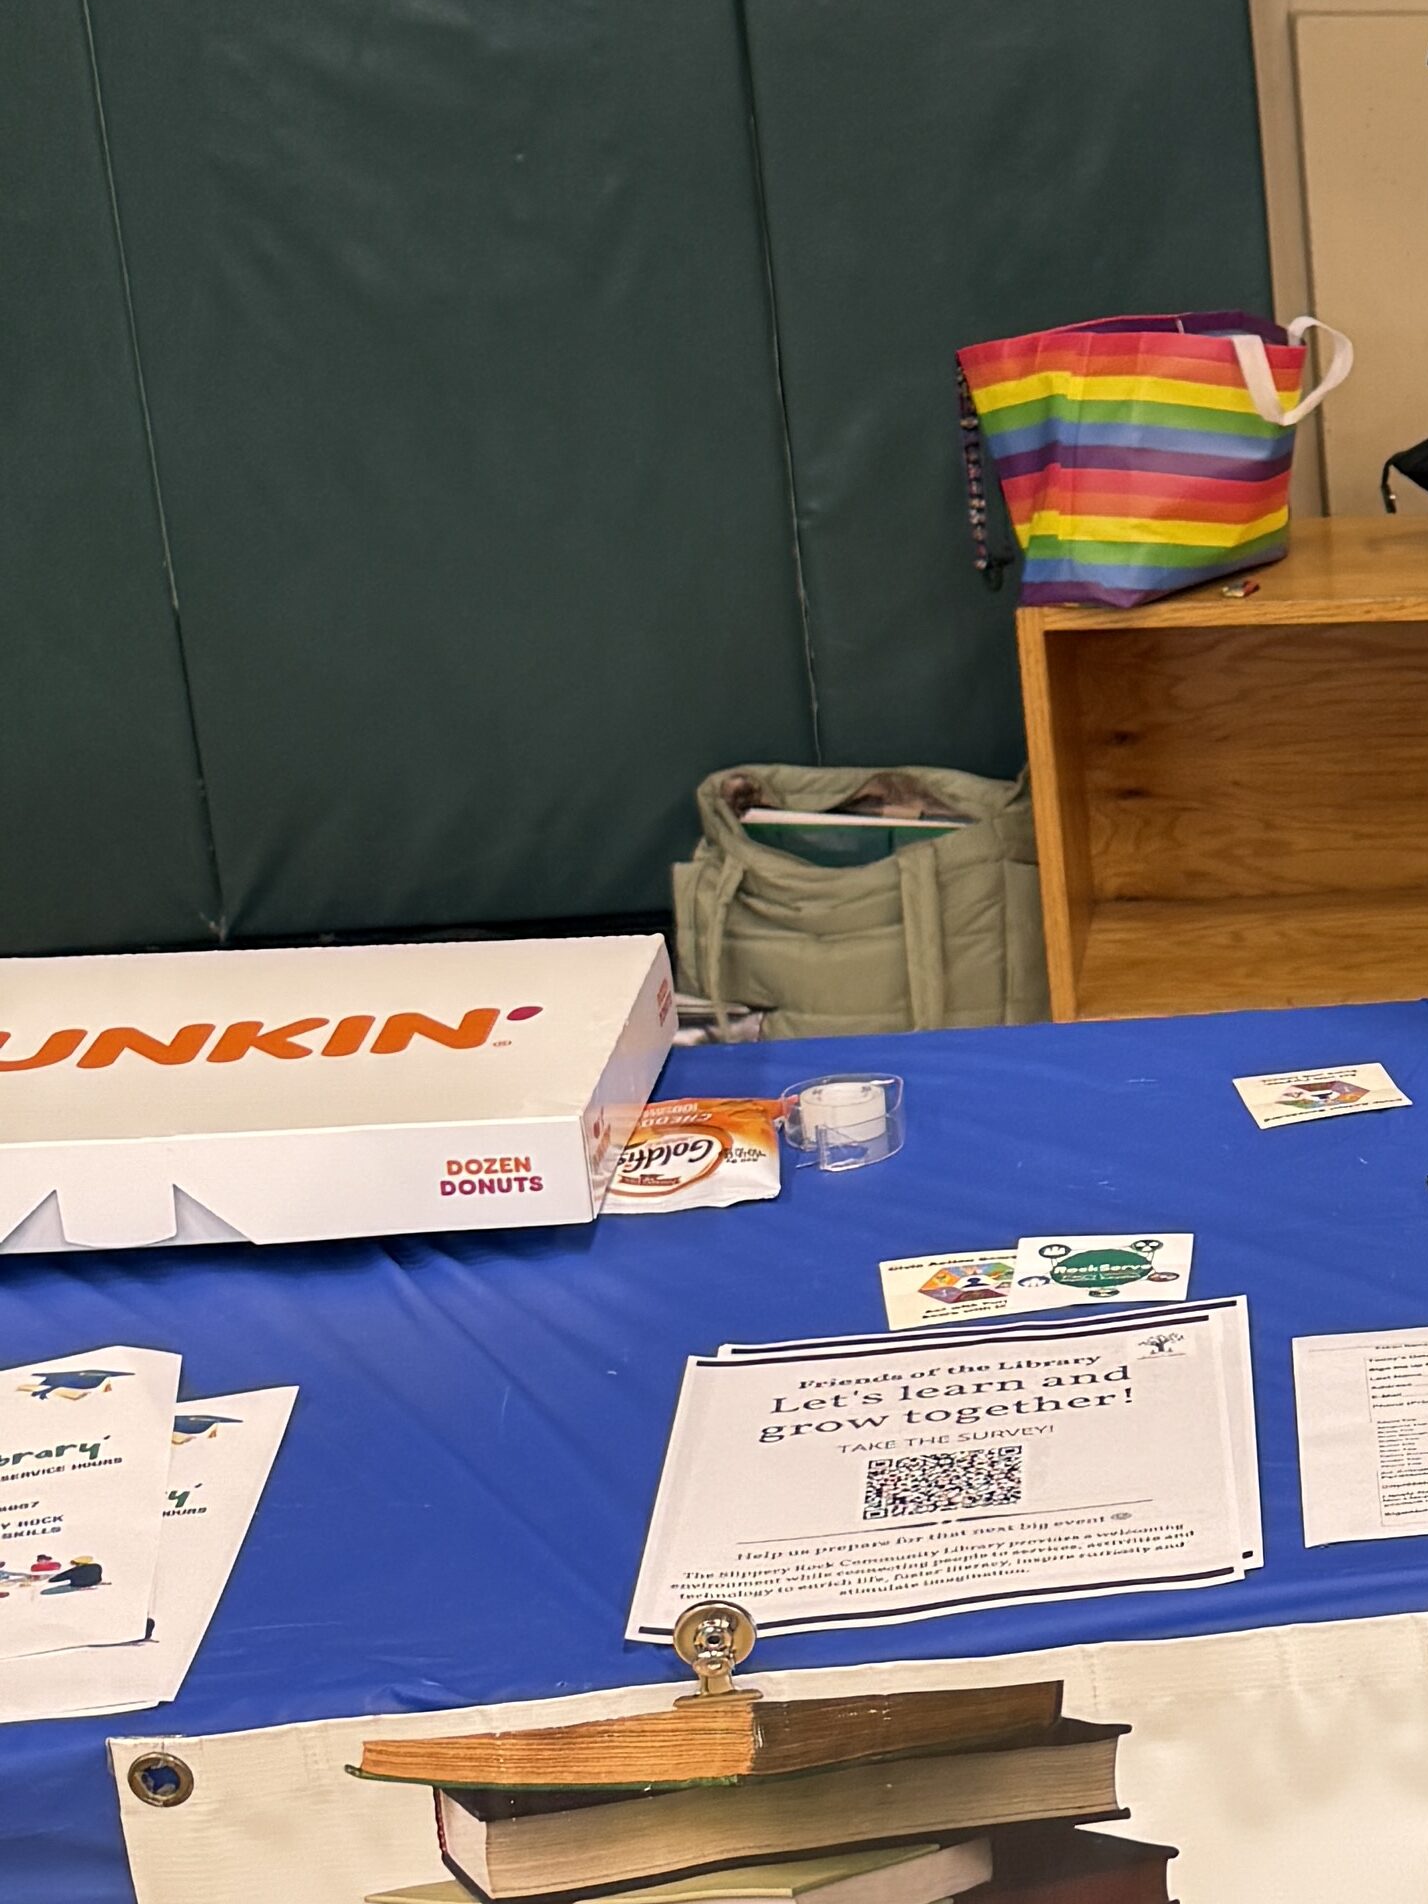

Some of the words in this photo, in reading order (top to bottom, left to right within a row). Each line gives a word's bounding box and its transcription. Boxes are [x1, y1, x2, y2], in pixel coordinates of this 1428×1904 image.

[640, 1112, 712, 1127] CHEDD
[446, 1157, 531, 1176] DOZEN
[616, 1139, 714, 1173] Goldfis
[440, 1176, 544, 1196] DONUTS
[1054, 1263, 1152, 1275] RockServe
[799, 1374, 902, 1389] Friends
[911, 1368, 940, 1378] of
[948, 1366, 990, 1374] the
[999, 1356, 1100, 1370] Library
[771, 1391, 882, 1413] Let's
[900, 1380, 1024, 1400] learn
[1042, 1366, 1130, 1387] and
[759, 1416, 888, 1443] grow
[905, 1388, 1132, 1424] together!
[838, 1440, 896, 1453] TAKE
[907, 1435, 950, 1446] THE
[957, 1424, 1054, 1443] SURVEY!
